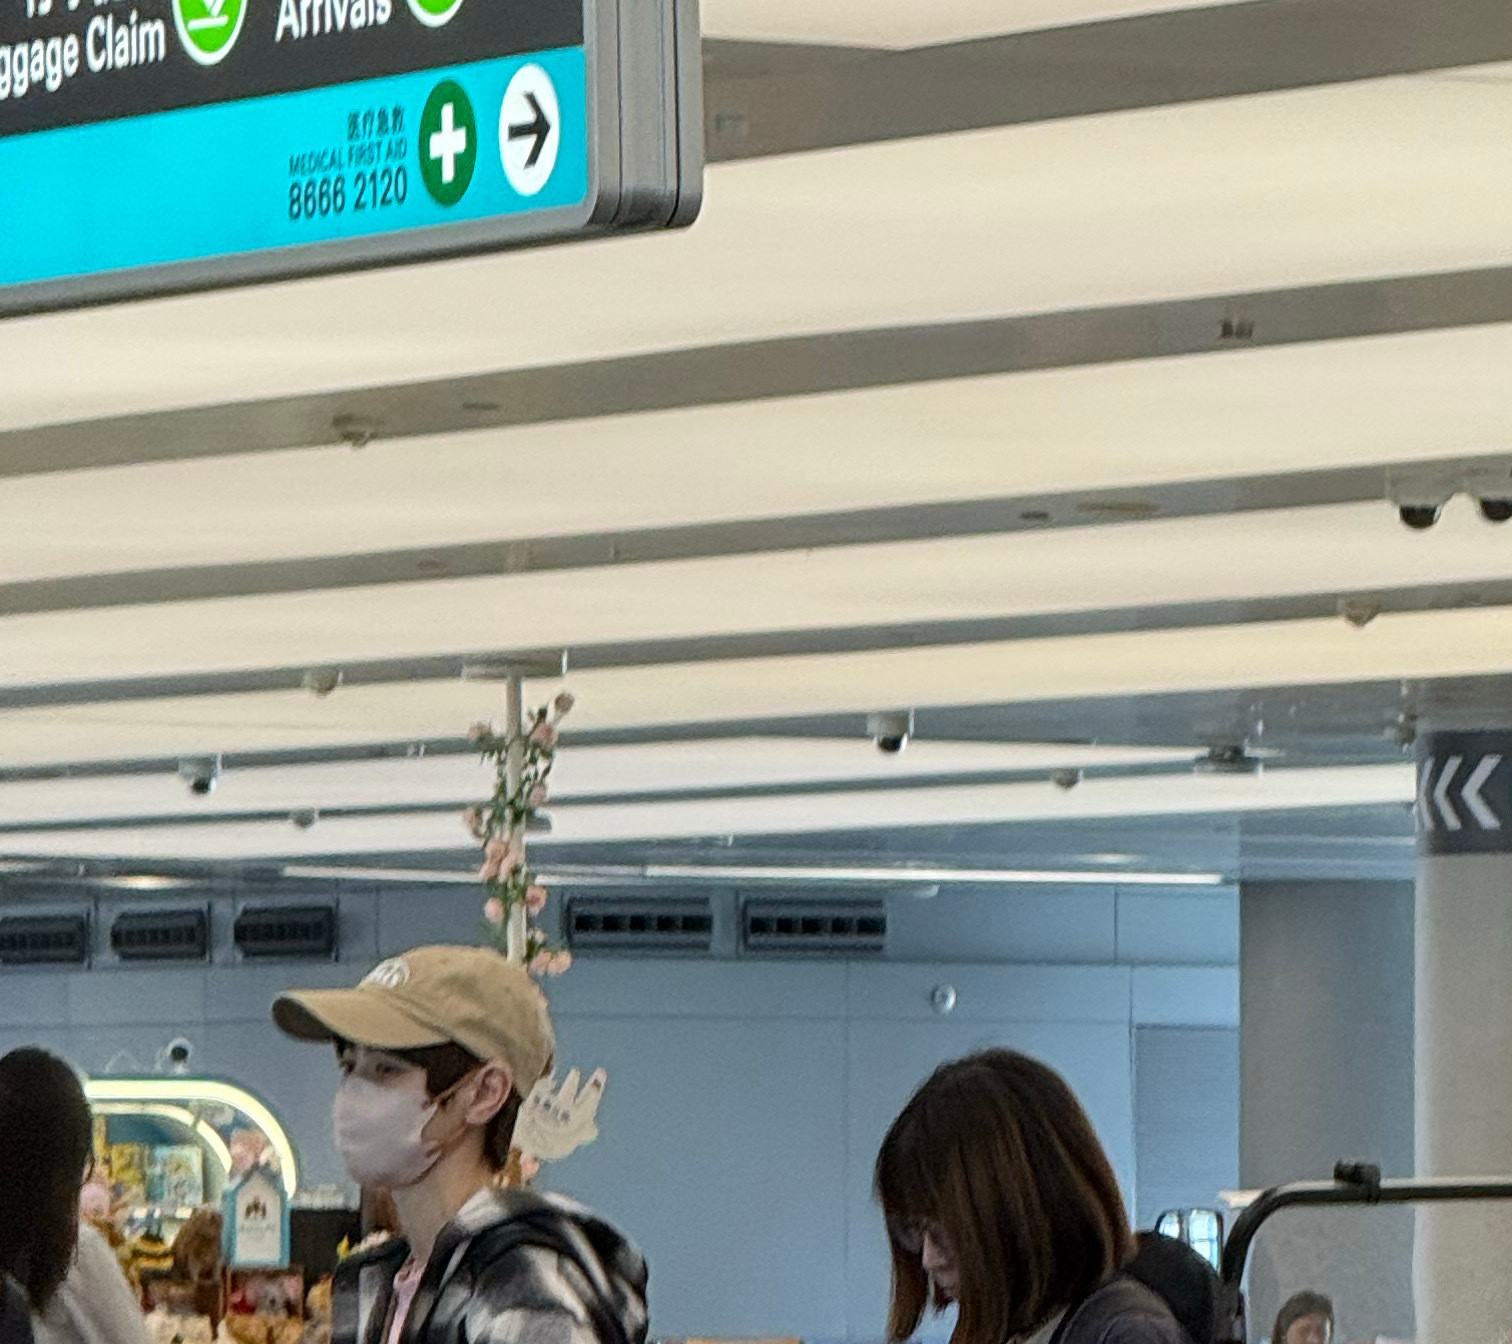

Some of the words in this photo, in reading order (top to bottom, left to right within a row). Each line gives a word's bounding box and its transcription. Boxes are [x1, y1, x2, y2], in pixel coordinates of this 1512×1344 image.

[86, 8, 166, 72] Claim
[289, 146, 344, 176] MEDICAL
[289, 174, 345, 220] 8666
[354, 165, 407, 212] 2120
